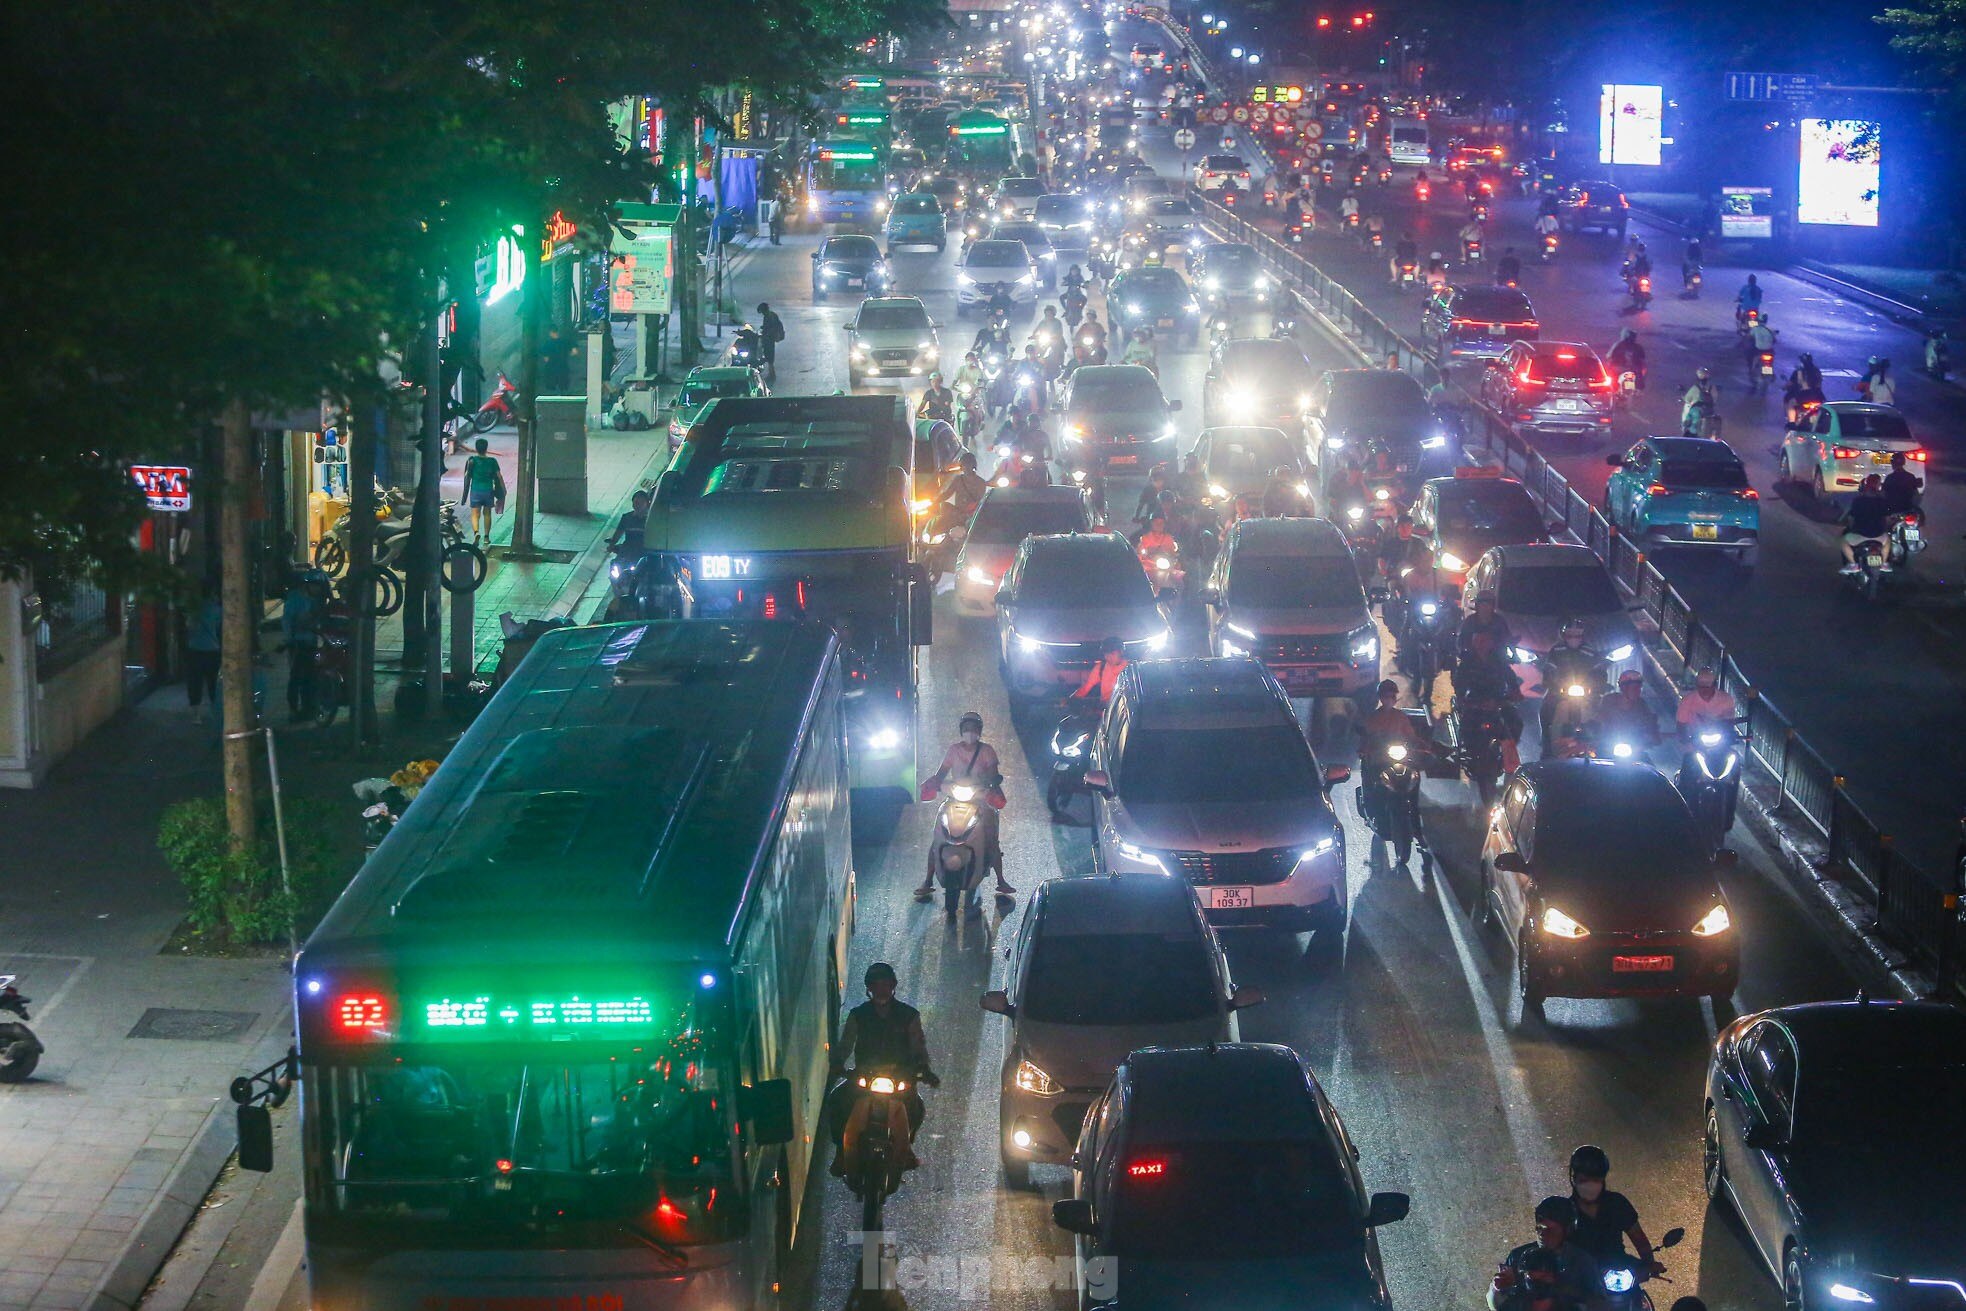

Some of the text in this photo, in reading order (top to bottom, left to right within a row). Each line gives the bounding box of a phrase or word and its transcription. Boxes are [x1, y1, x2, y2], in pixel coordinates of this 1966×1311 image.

[1223, 889, 1241, 899] 30K
[341, 999, 384, 1027] 02
[1131, 1163, 1162, 1175] TAXI
